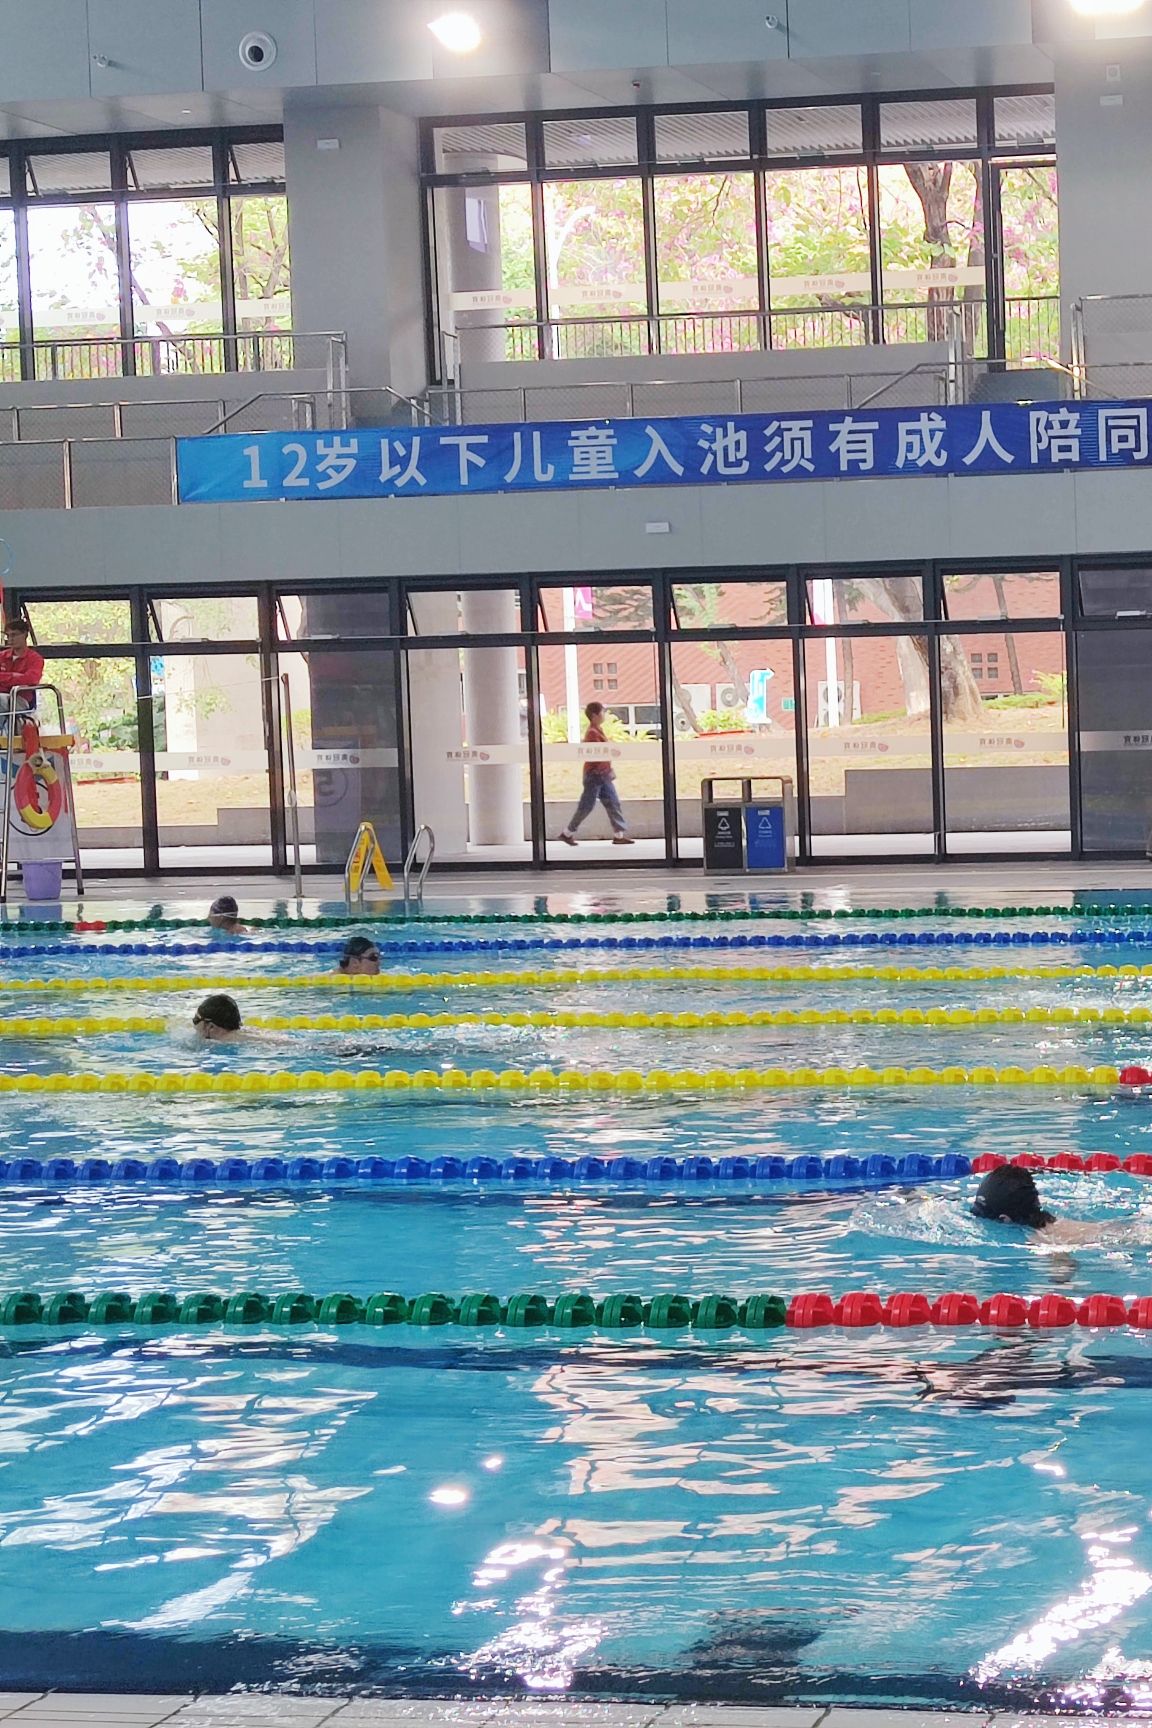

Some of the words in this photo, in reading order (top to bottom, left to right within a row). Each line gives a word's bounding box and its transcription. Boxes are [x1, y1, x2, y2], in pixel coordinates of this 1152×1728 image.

[242, 406, 1149, 490] 12岁以下儿童入池须有成人陪同
